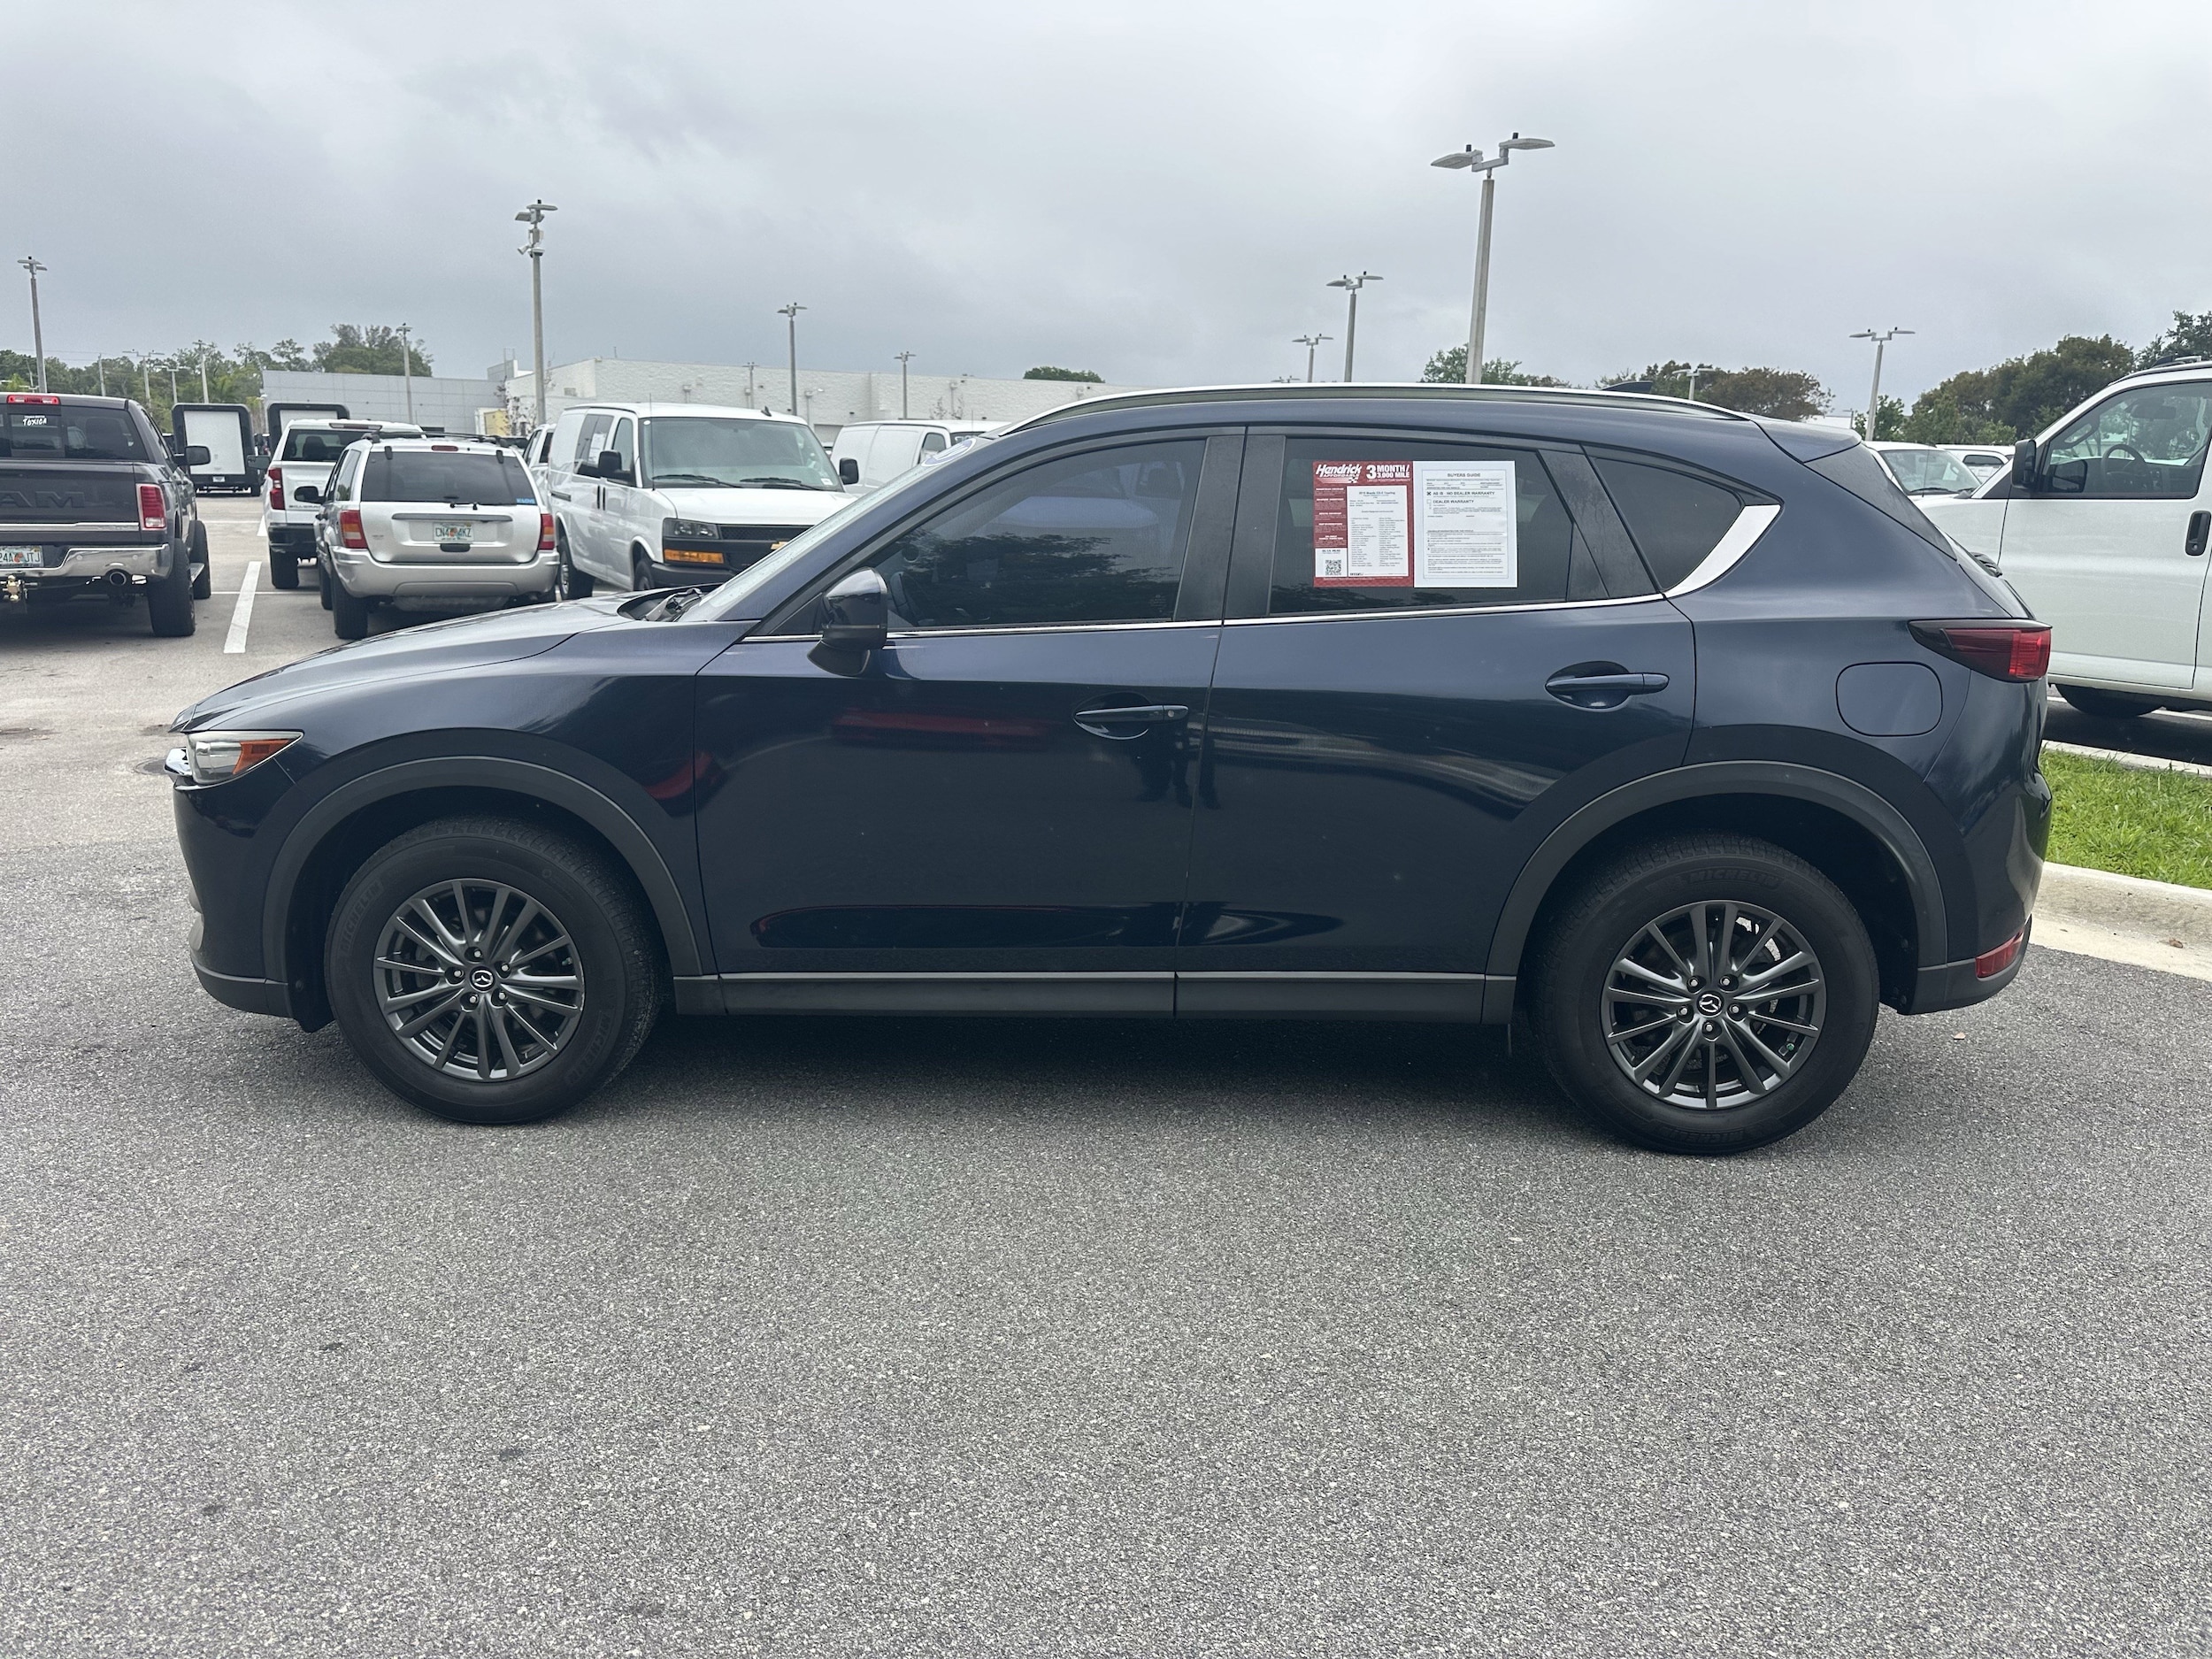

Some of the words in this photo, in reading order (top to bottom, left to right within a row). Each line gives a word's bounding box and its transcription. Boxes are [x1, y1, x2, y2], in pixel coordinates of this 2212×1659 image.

[1316, 464, 1363, 478] Hendrick
[1366, 465, 1377, 480] 3
[25, 552, 41, 563] JTJ
[1689, 869, 1780, 887] MICHELIN
[340, 880, 382, 953] MICHELIN
